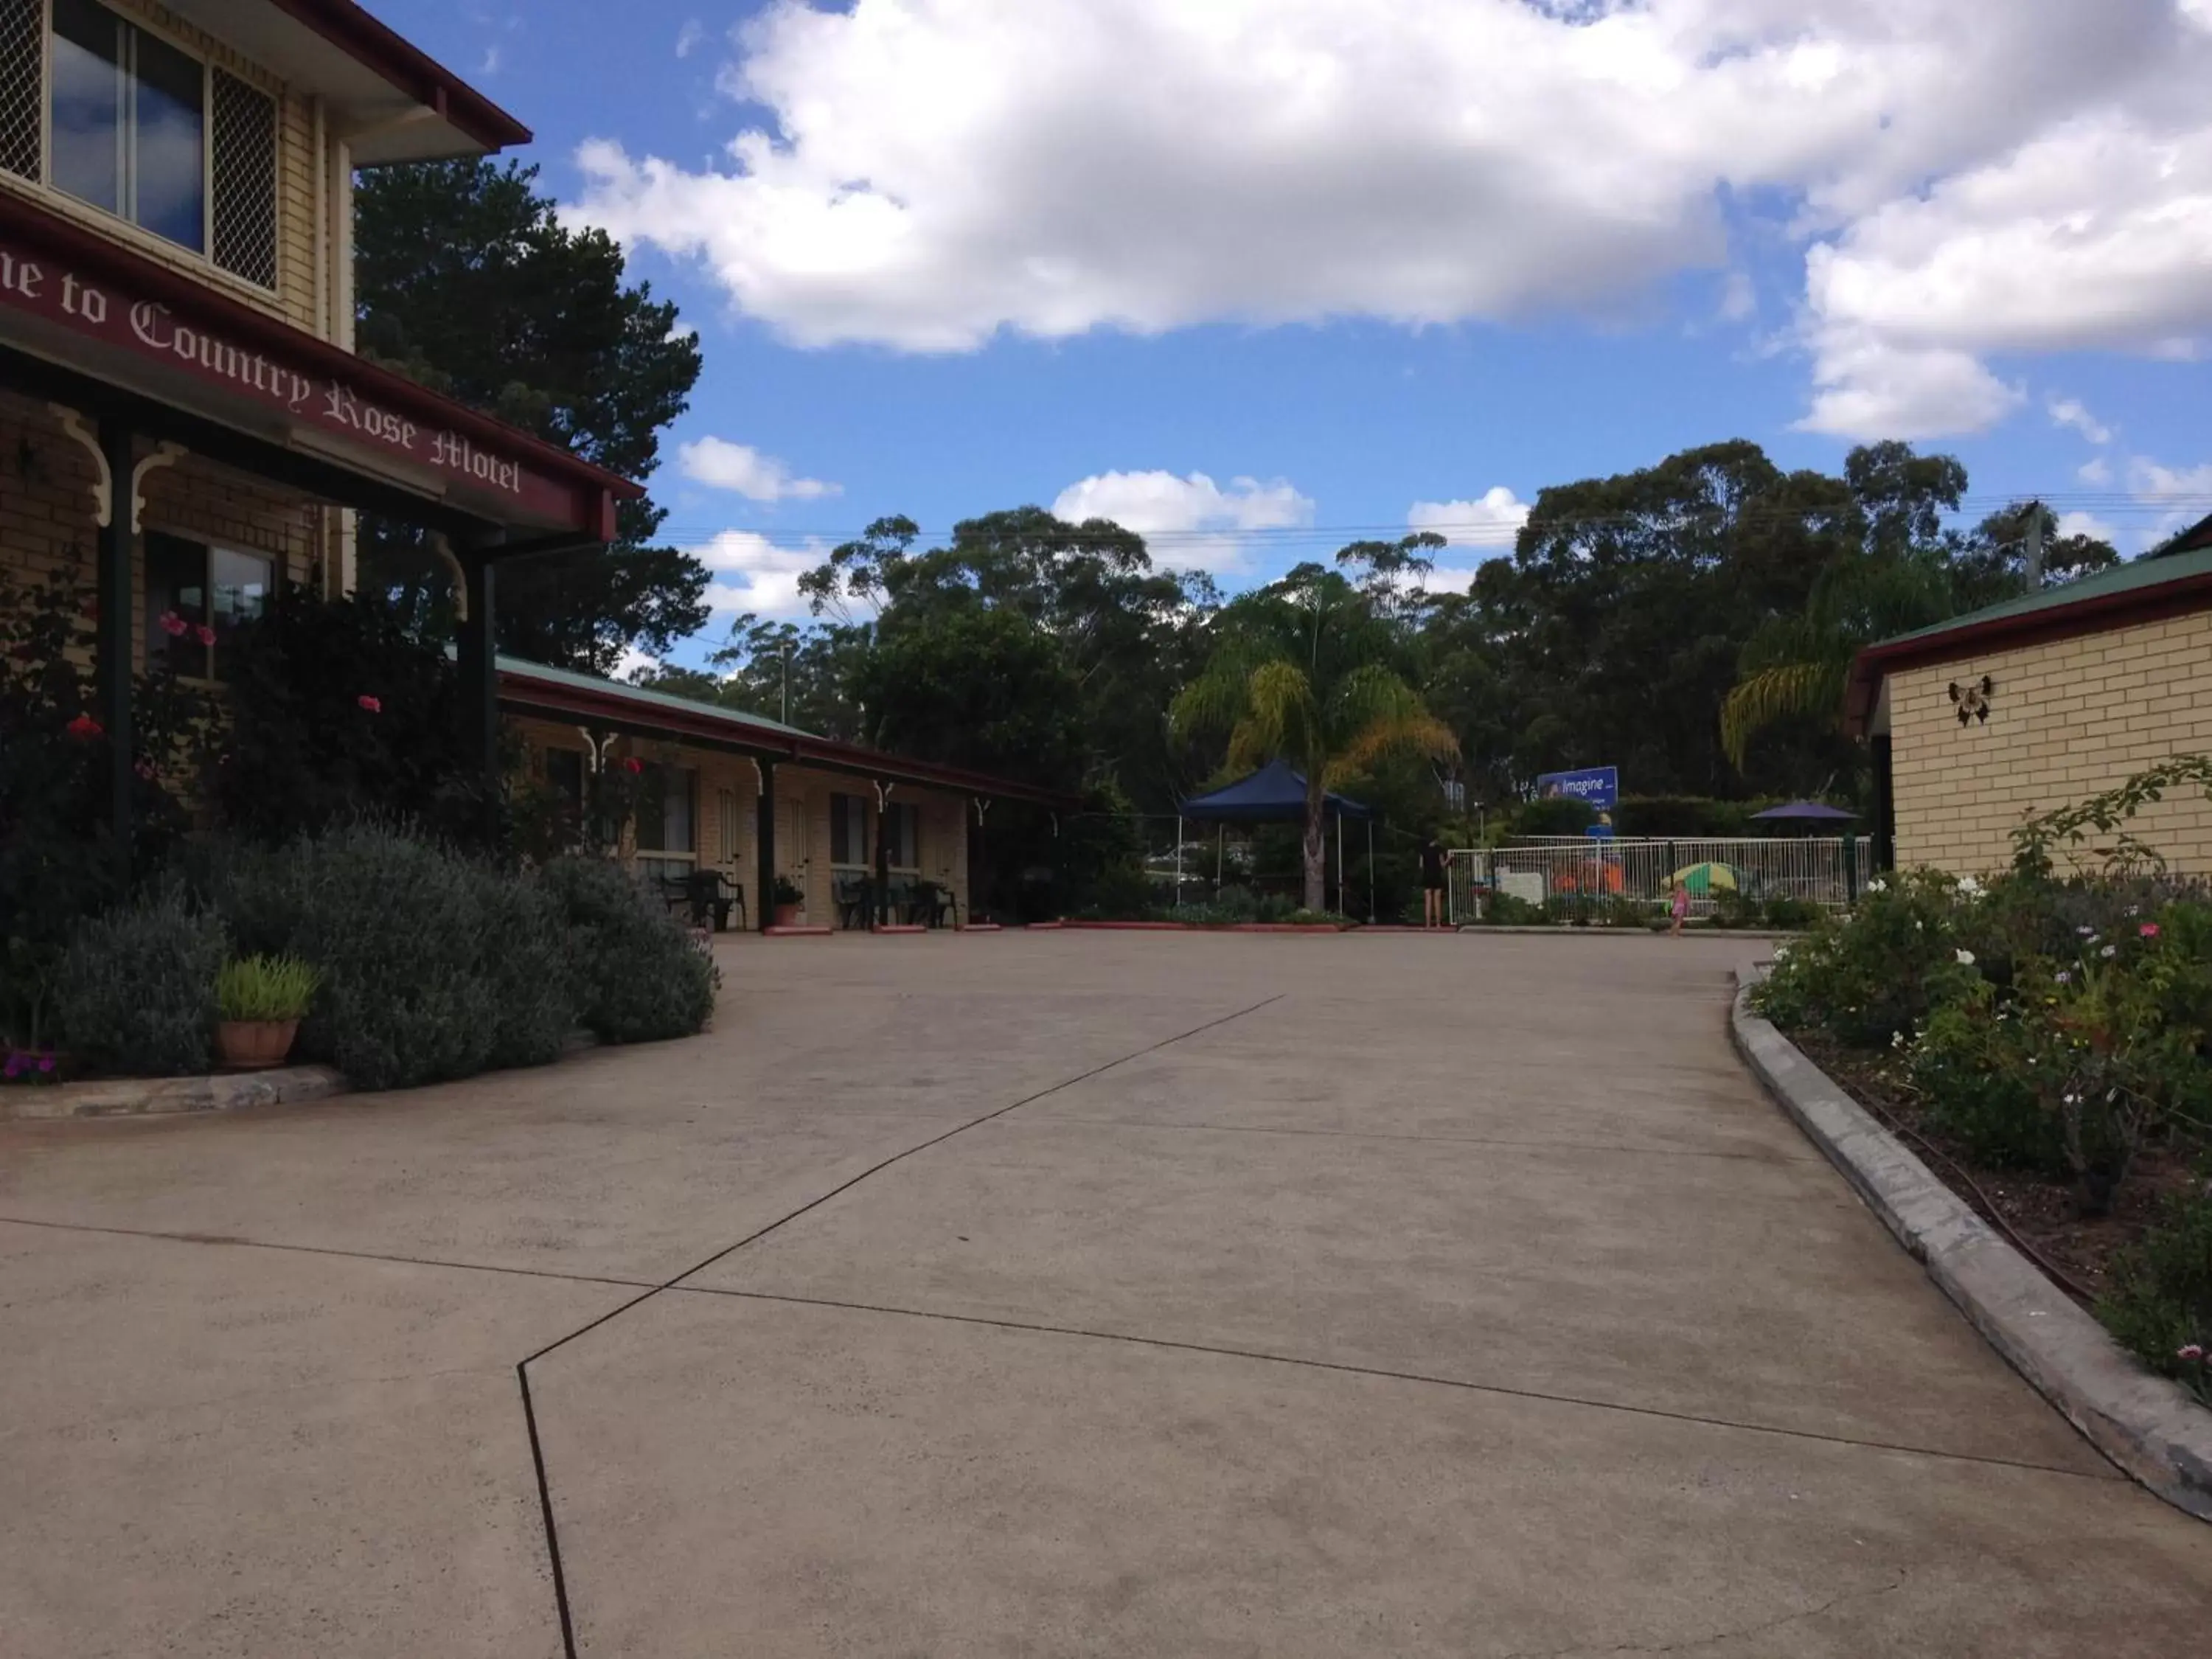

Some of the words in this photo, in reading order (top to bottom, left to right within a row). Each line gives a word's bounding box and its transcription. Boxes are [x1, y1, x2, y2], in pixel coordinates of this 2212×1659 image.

[60, 272, 107, 324] to
[130, 299, 311, 414] Country
[323, 378, 417, 450] Rose
[430, 428, 519, 493] Motel
[1562, 778, 1604, 796] Imagine
